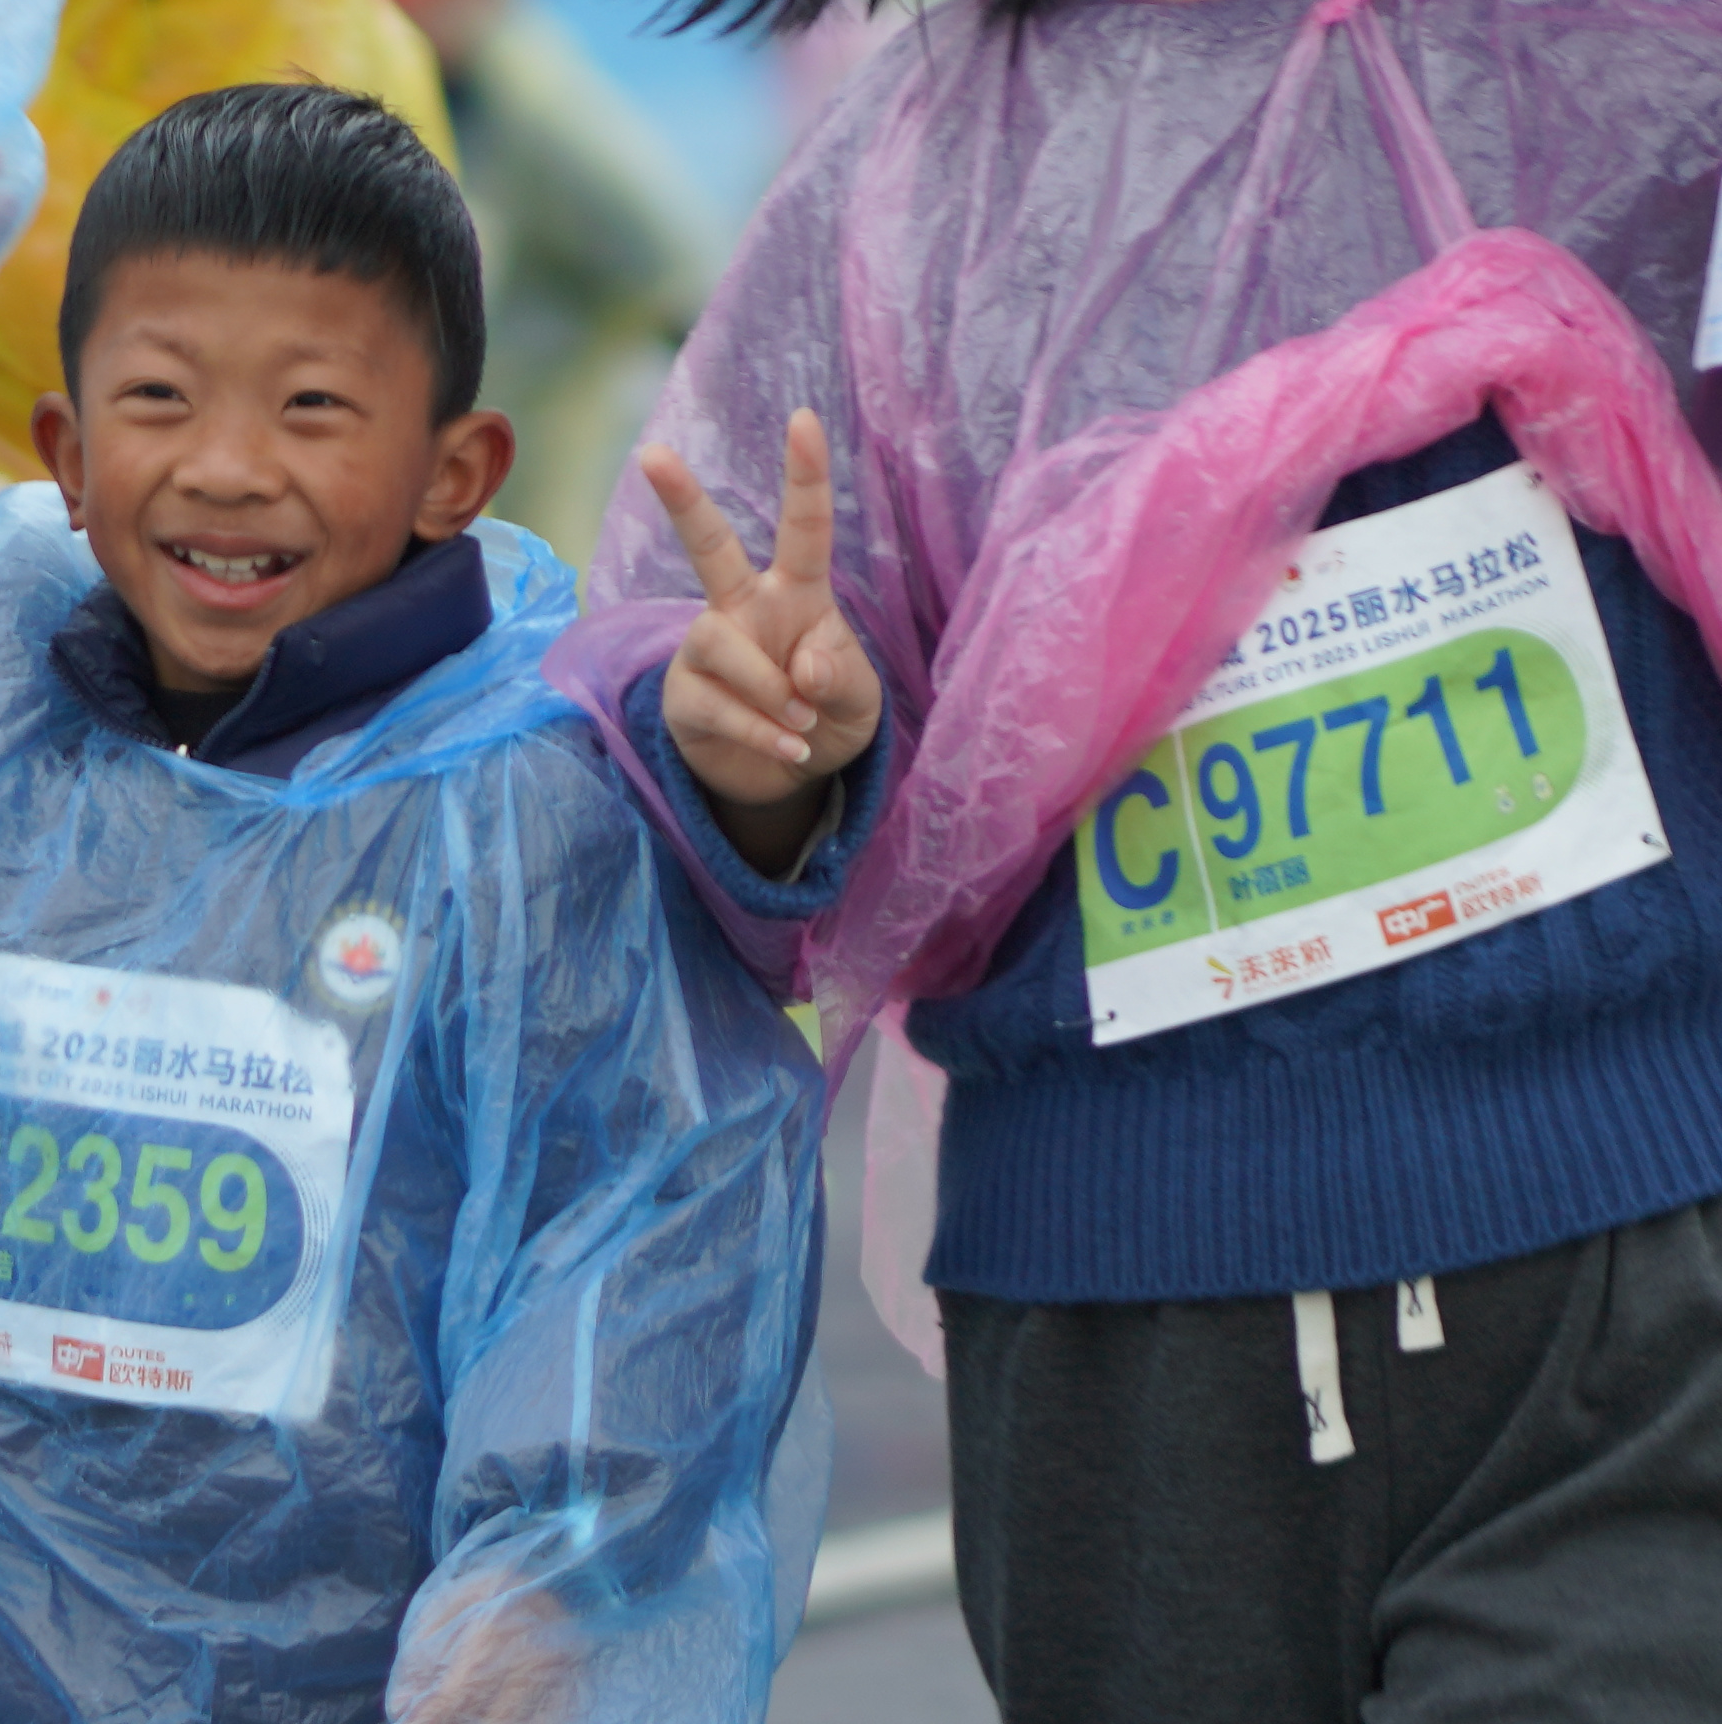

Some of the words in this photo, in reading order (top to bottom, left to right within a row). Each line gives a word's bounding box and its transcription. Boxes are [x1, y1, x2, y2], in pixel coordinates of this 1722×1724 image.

[1255, 531, 1542, 654] 2025丽水马拉松
[1093, 768, 1179, 911] C
[1197, 647, 1540, 859] 97711
[40, 1026, 315, 1096] 2025丽水马拉松
[130, 1082, 188, 1106] LISHUI
[199, 1092, 314, 1123] MARATHON
[108, 1361, 194, 1393] 欧特斯
